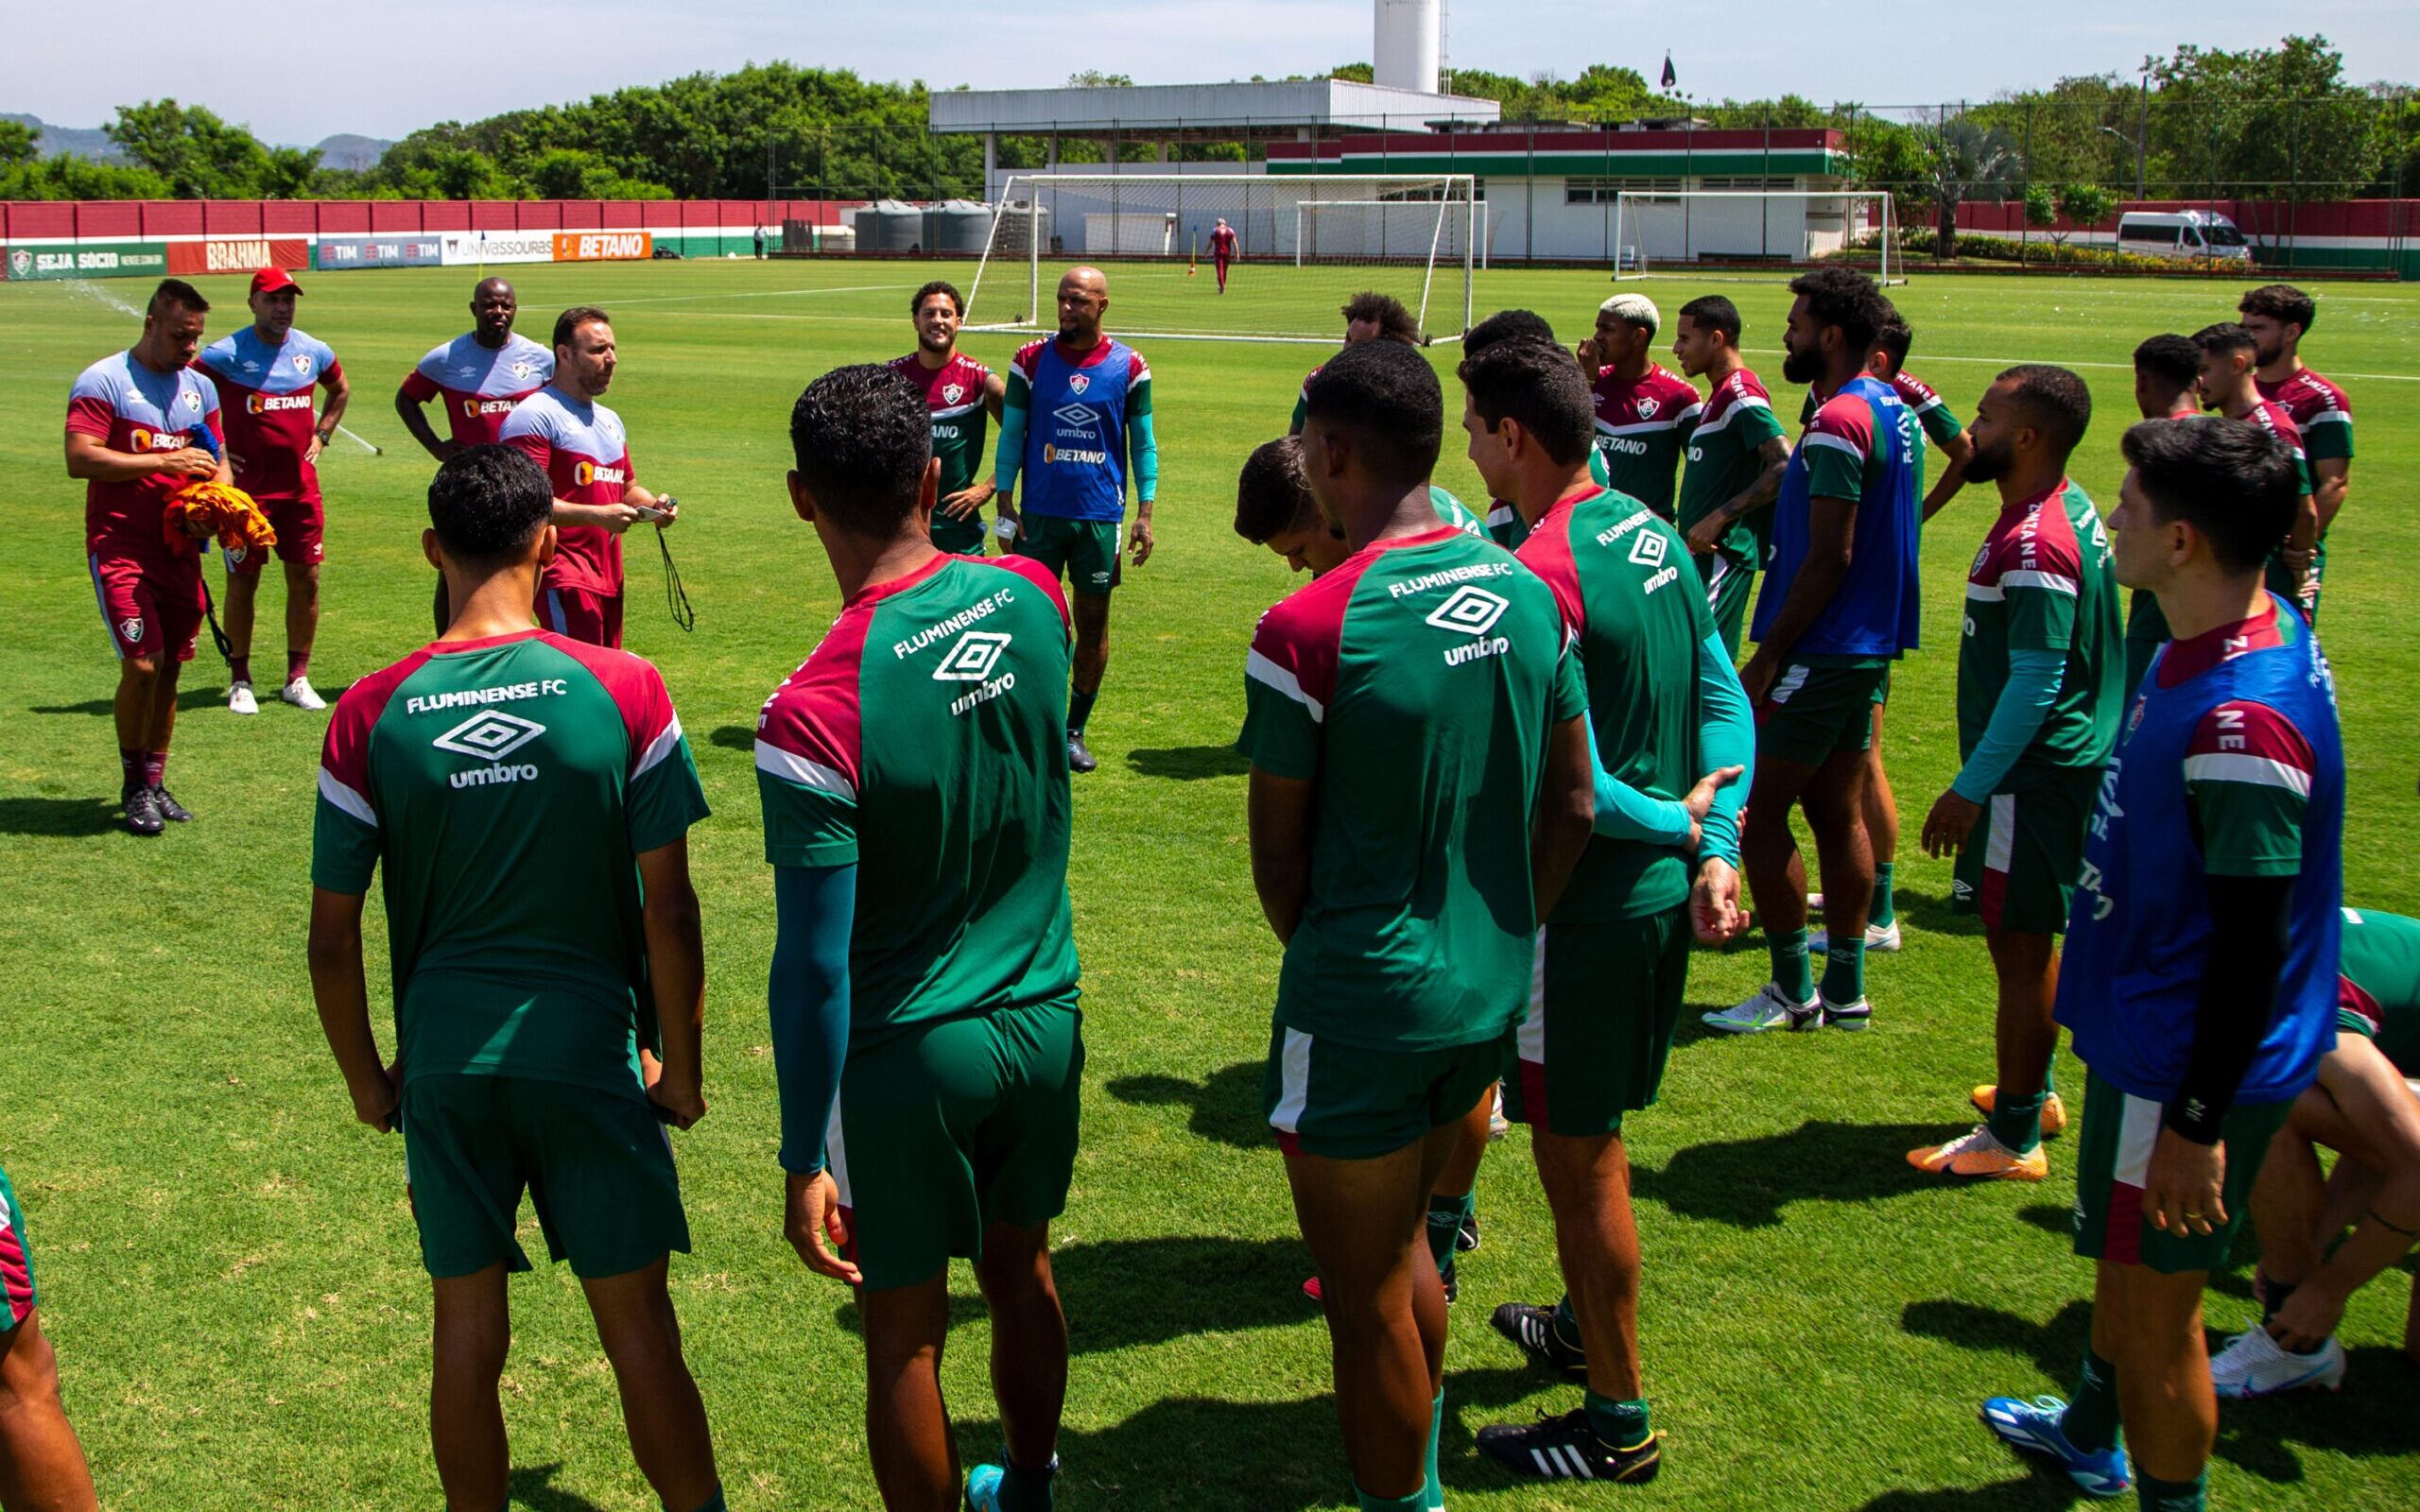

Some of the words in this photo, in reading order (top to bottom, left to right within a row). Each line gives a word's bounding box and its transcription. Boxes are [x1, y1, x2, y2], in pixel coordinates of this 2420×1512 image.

[206, 241, 272, 270] BRAHMA
[335, 245, 357, 260] TIM
[377, 244, 399, 258] TIM
[418, 243, 439, 257] TIM
[579, 234, 643, 257] BETANO
[36, 253, 75, 270] SEJA
[78, 251, 118, 268] SÓCIO
[264, 395, 311, 410] BETANO
[1056, 426, 1096, 439] umbro
[1595, 435, 1647, 455] BETANO
[1055, 449, 1106, 465] BETANO
[1388, 564, 1495, 599] FLUMINENSE
[1492, 562, 1512, 576] FC
[1643, 566, 1678, 595] umbro
[893, 597, 995, 661] FLUMINENSE
[994, 588, 1015, 610] FC
[1444, 635, 1510, 667] umbro
[406, 682, 538, 714] FLUMINENSE
[541, 679, 567, 696] FC
[951, 672, 1015, 716] umbro
[450, 763, 539, 789] umbro
